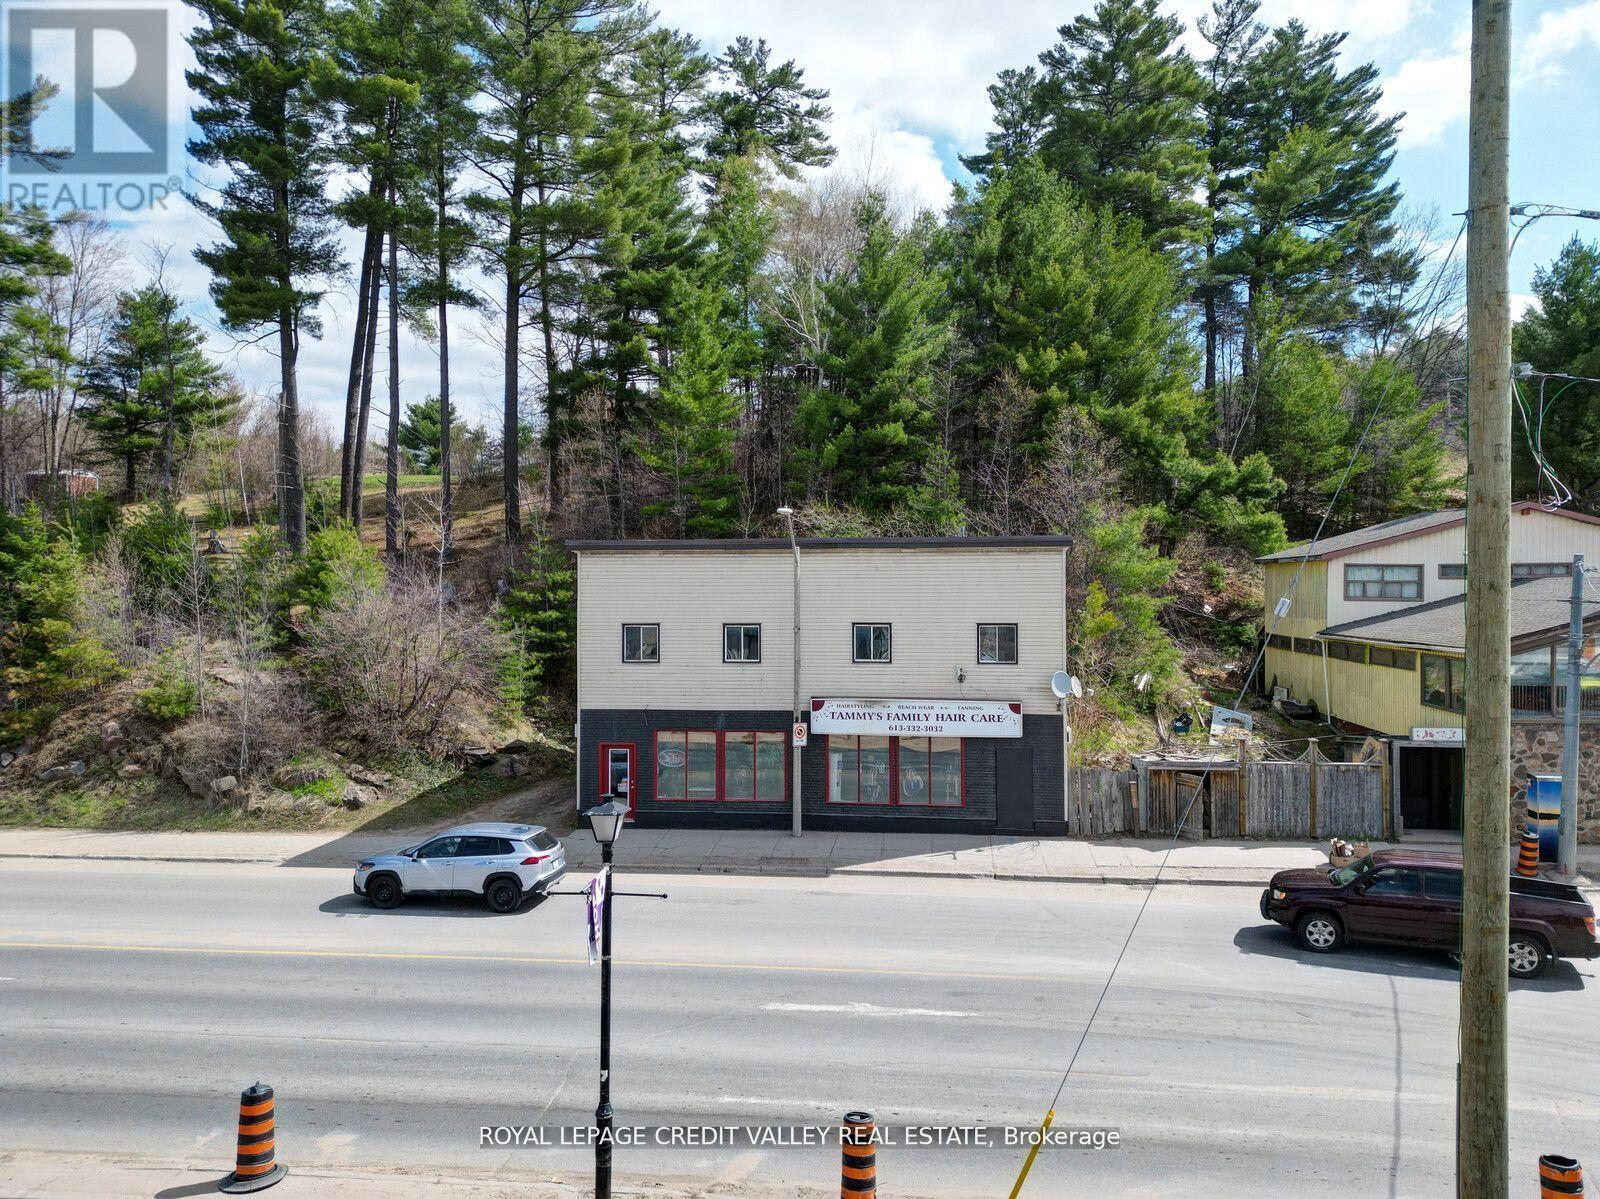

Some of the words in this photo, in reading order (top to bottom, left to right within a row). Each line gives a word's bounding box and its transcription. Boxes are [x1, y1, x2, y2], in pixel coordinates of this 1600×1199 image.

[829, 712, 883, 721] TAMMY'S
[886, 713, 932, 722] FAMILY
[935, 713, 967, 722] HAIR
[971, 714, 1004, 723] CARE
[888, 725, 944, 733] 613-332-3032
